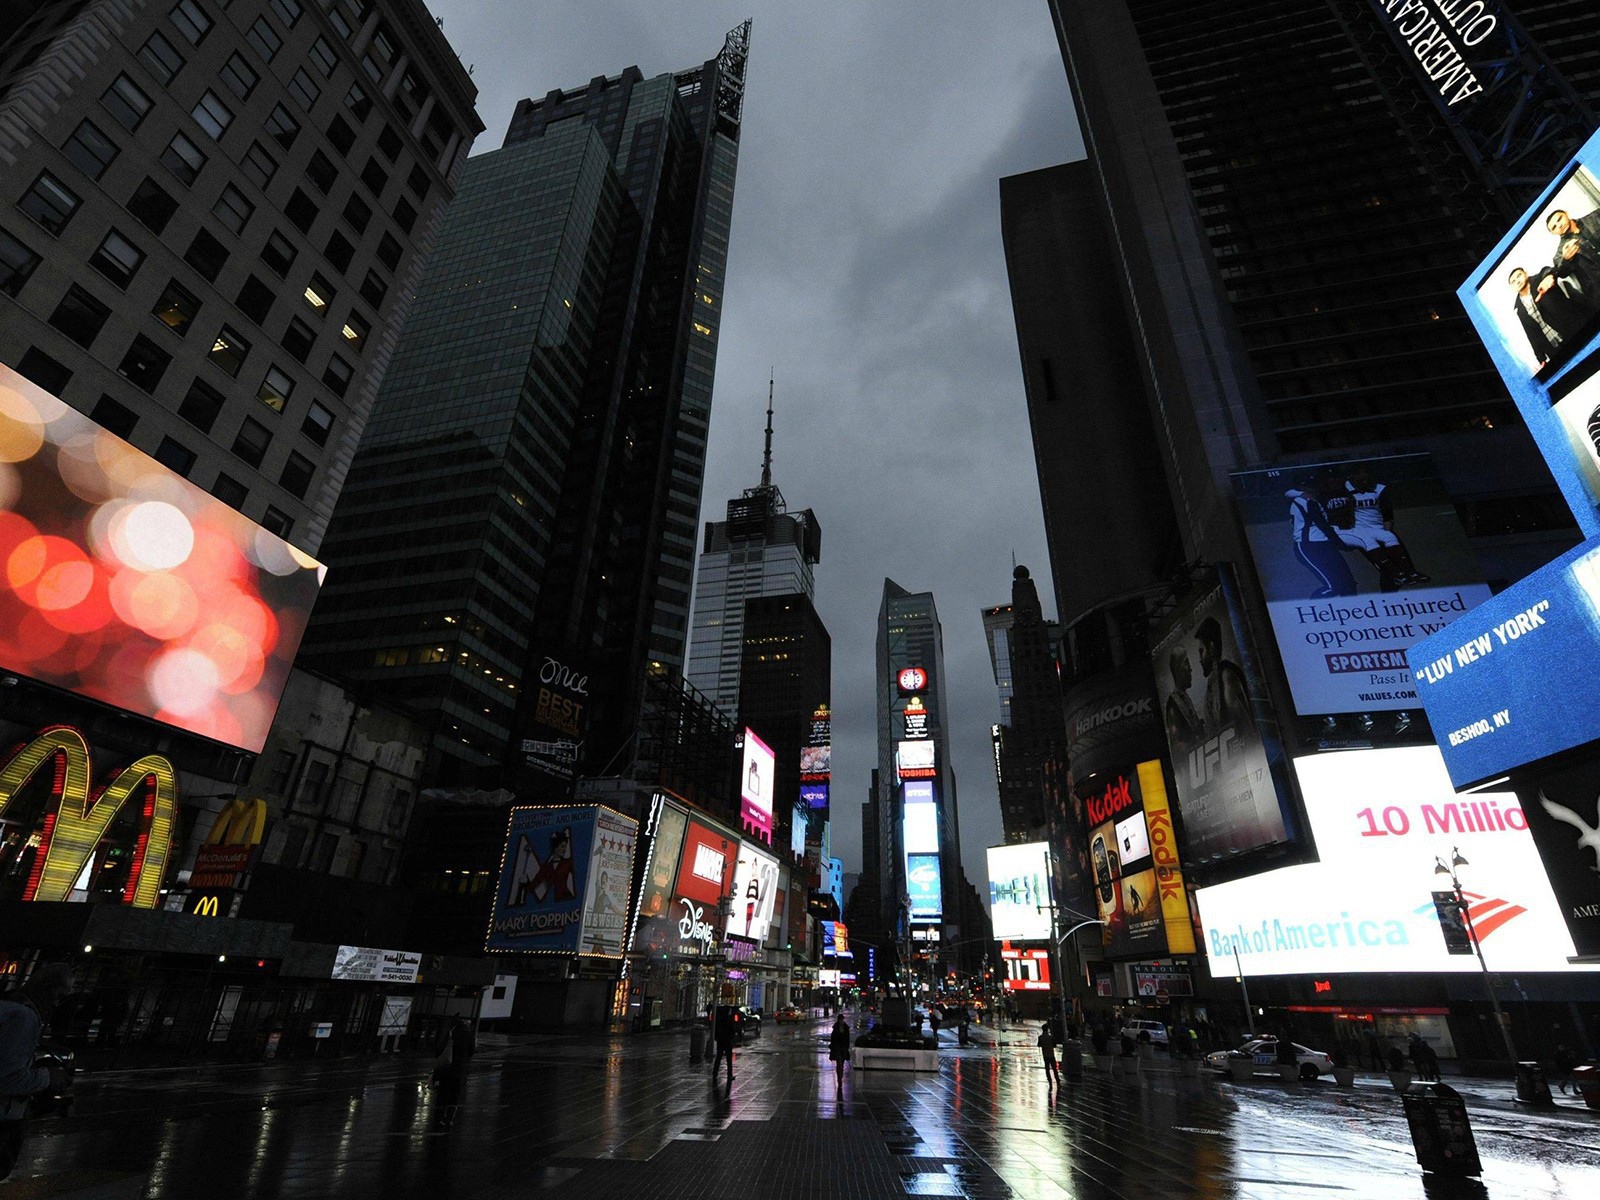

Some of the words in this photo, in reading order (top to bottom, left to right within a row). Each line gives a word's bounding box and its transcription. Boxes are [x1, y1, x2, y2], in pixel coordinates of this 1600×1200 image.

[1433, 0, 1496, 46] OUT
[1296, 600, 1378, 625] Helped
[1382, 592, 1467, 620] injured
[1305, 624, 1415, 649] opponent
[1454, 632, 1493, 668] NEW
[1359, 689, 1418, 701] VALUES.COM
[1370, 673, 1396, 685] Pass
[1400, 672, 1410, 683] It
[538, 687, 584, 721] BEST
[1448, 718, 1495, 747] BESHOO,
[1493, 709, 1511, 728] NY
[900, 768, 936, 778] TOSHIBA
[1188, 728, 1236, 790] UFC
[1086, 775, 1133, 827] Kodak
[1356, 806, 1411, 837] 10
[1420, 801, 1530, 834] Millio
[197, 853, 248, 863] McDonald's
[1148, 809, 1182, 901] Kodak
[493, 915, 529, 933] MARY
[530, 908, 581, 929] POPPINS
[1209, 924, 1253, 957] Bank
[1253, 919, 1271, 953] of
[1272, 911, 1409, 952] America
[1134, 965, 1191, 974] MARQUIS
